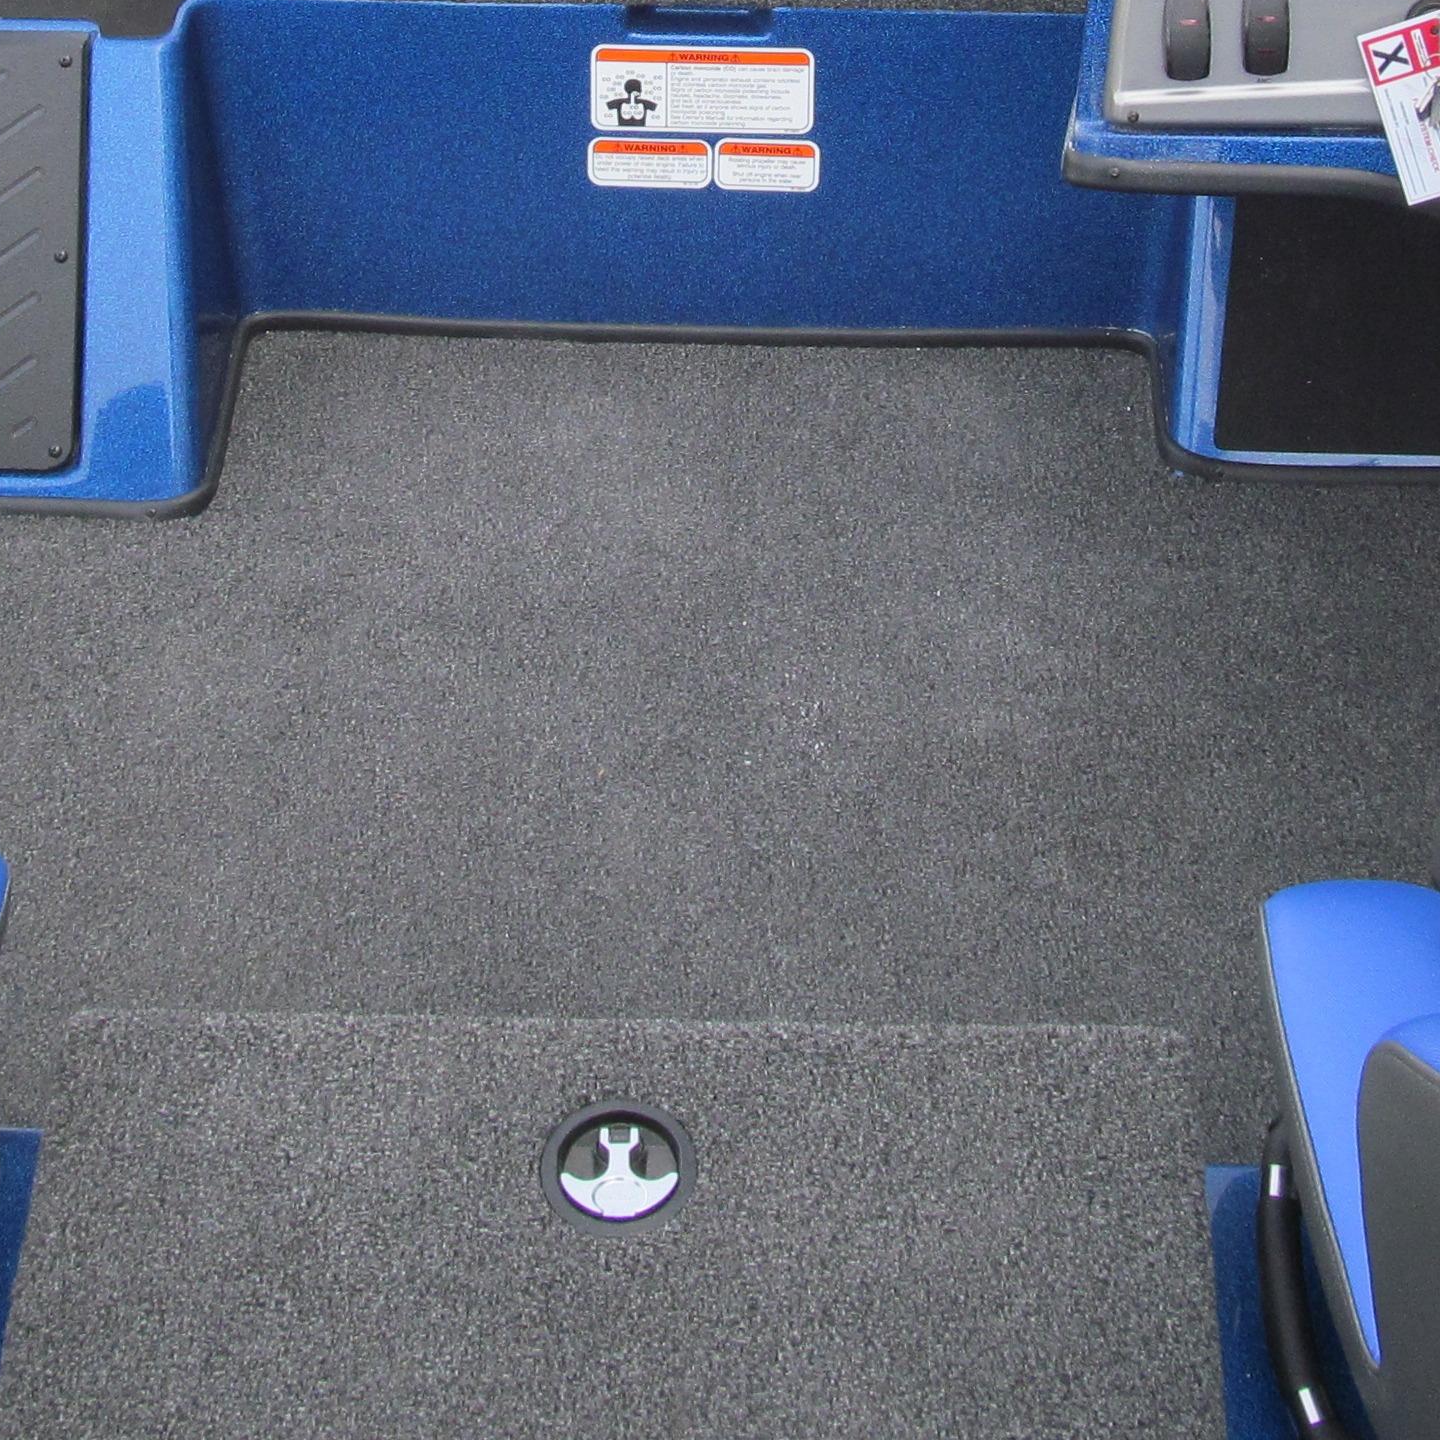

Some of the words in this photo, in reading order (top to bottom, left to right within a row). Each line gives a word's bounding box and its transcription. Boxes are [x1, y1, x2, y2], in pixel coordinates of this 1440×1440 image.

[679, 53, 729, 62] WARNING
[623, 143, 677, 153] WARNING
[741, 146, 792, 154] WARNING
